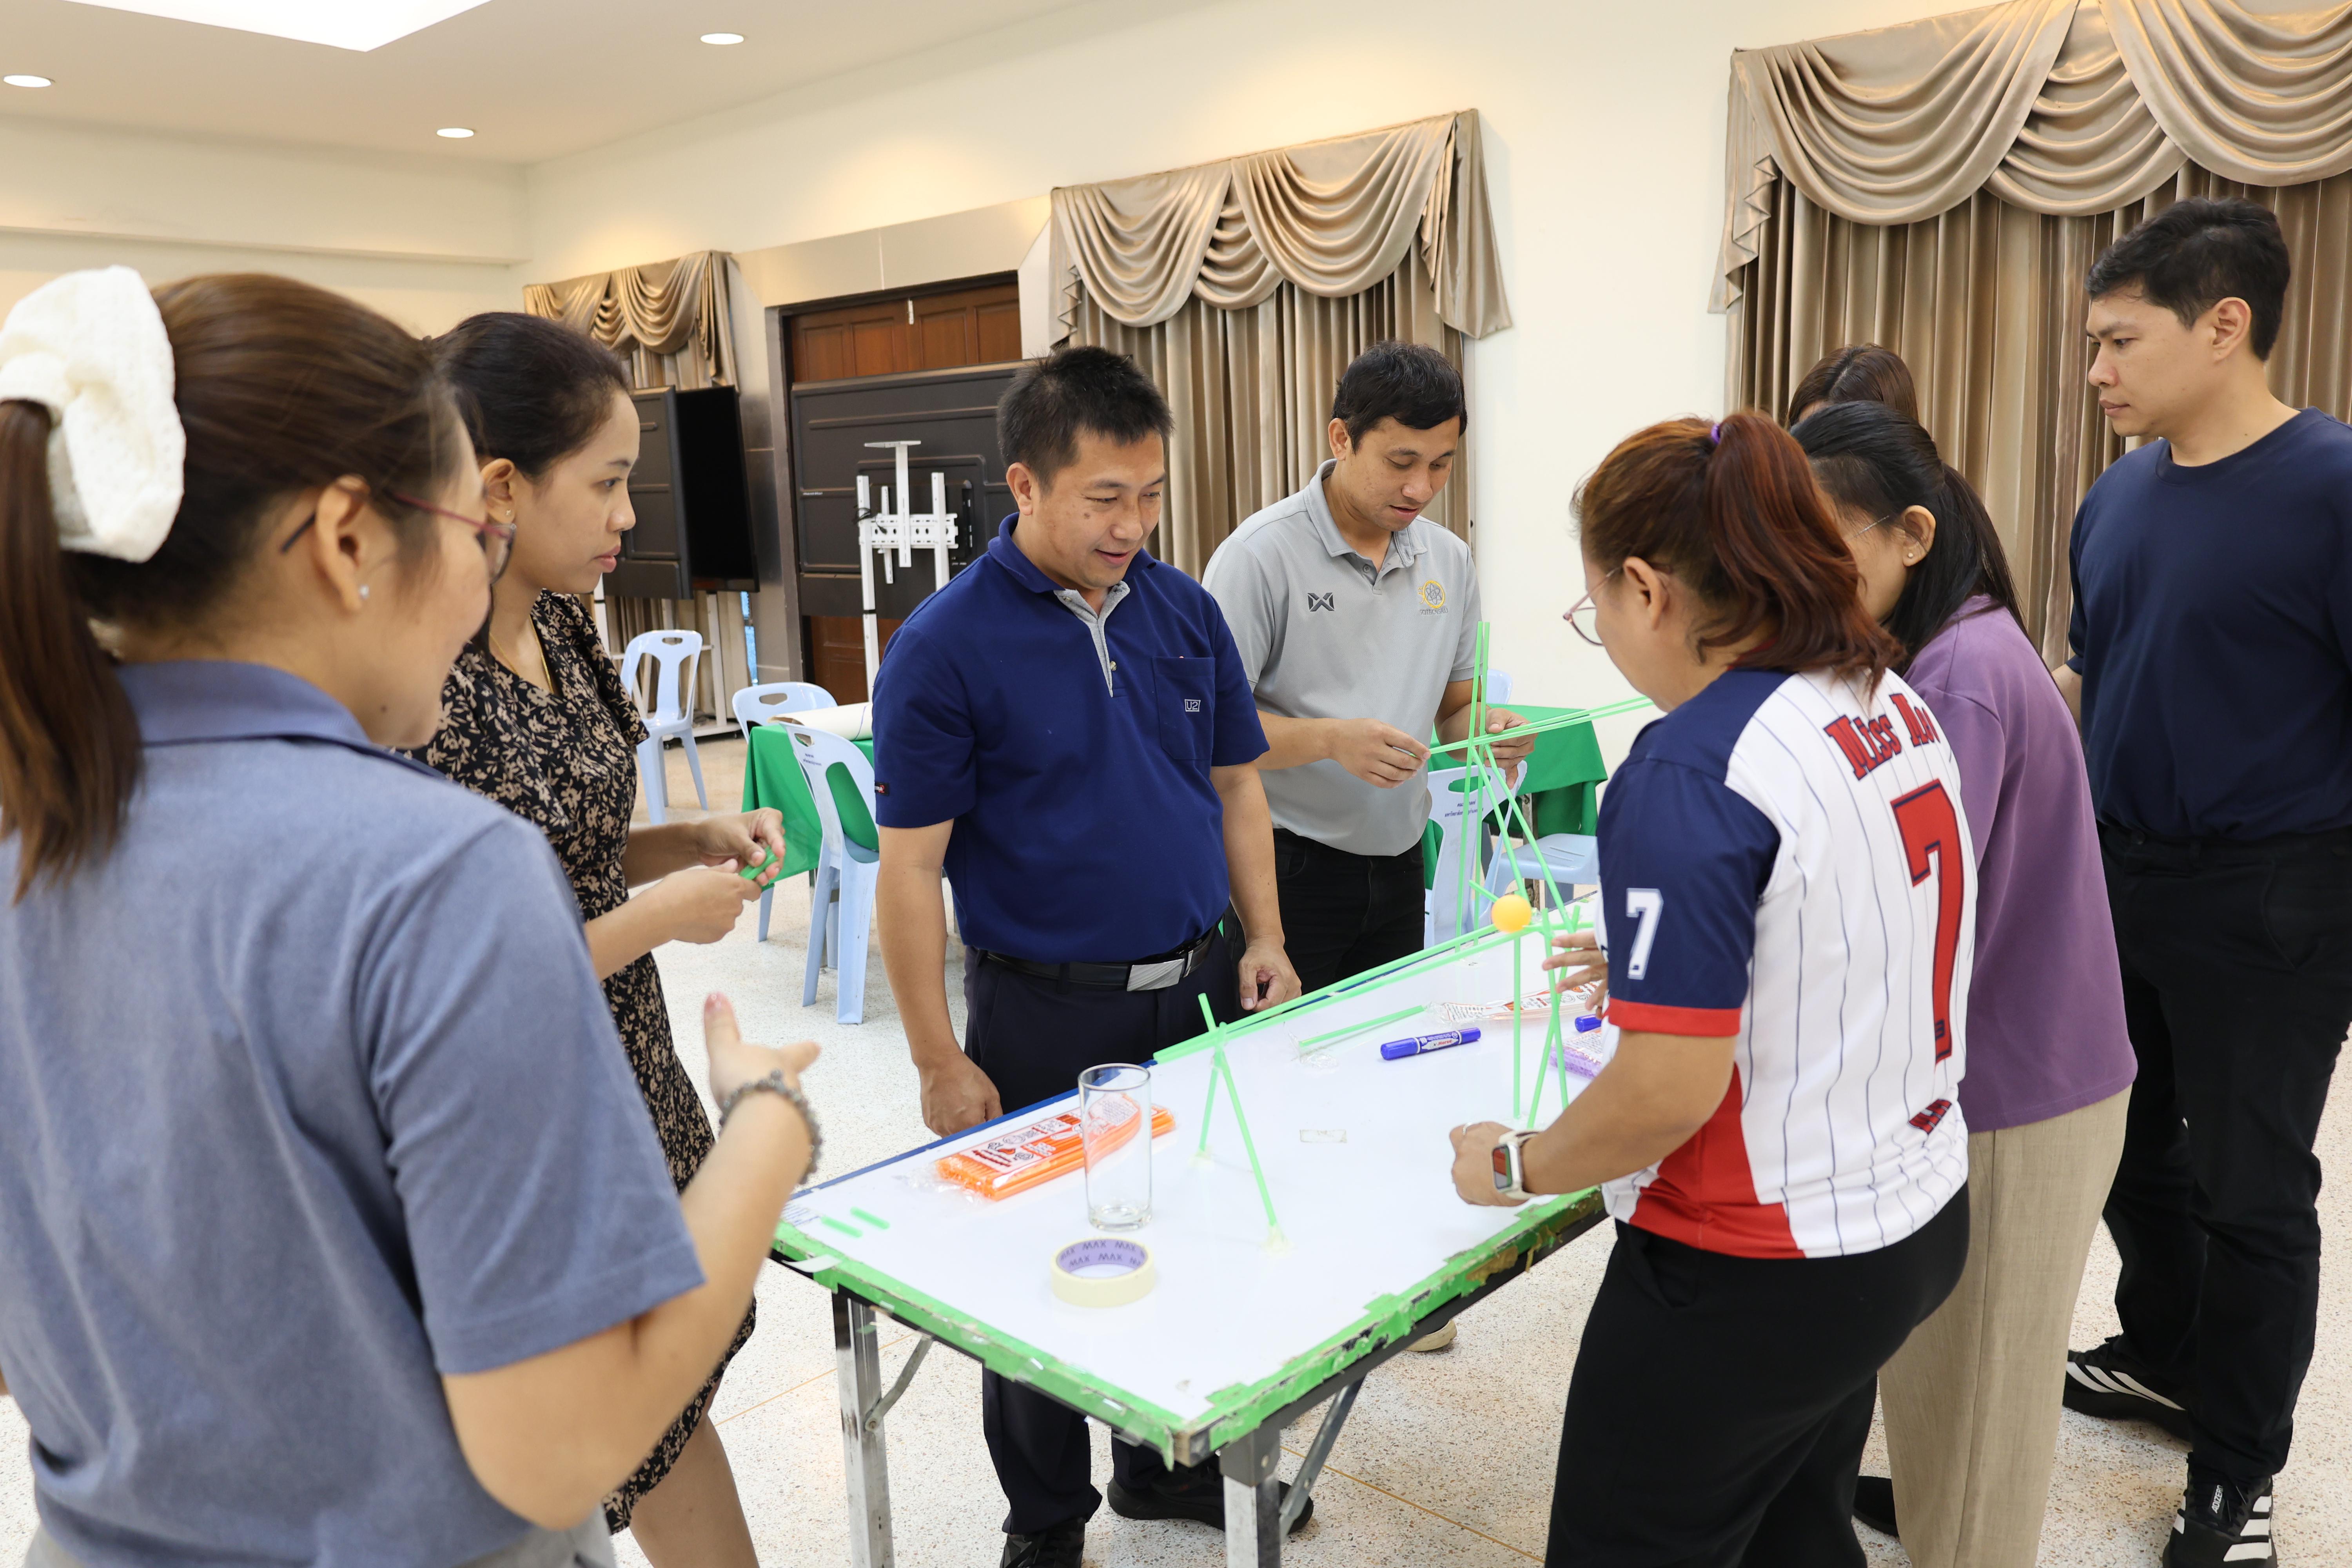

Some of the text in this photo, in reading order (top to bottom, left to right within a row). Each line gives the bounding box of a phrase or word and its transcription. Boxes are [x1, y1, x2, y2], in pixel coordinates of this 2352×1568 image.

[1186, 700, 1199, 710] U2
[1823, 714, 1902, 780] Miss
[1626, 887, 1664, 980] 7
[1890, 778, 1964, 1066] 7
[1069, 1255, 1090, 1267] MAX
[1099, 1252, 1123, 1261] MAX
[1082, 1240, 1106, 1250] MAX
[1115, 1241, 1136, 1252] MAX
[2212, 1484, 2224, 1514] ADIZERO
